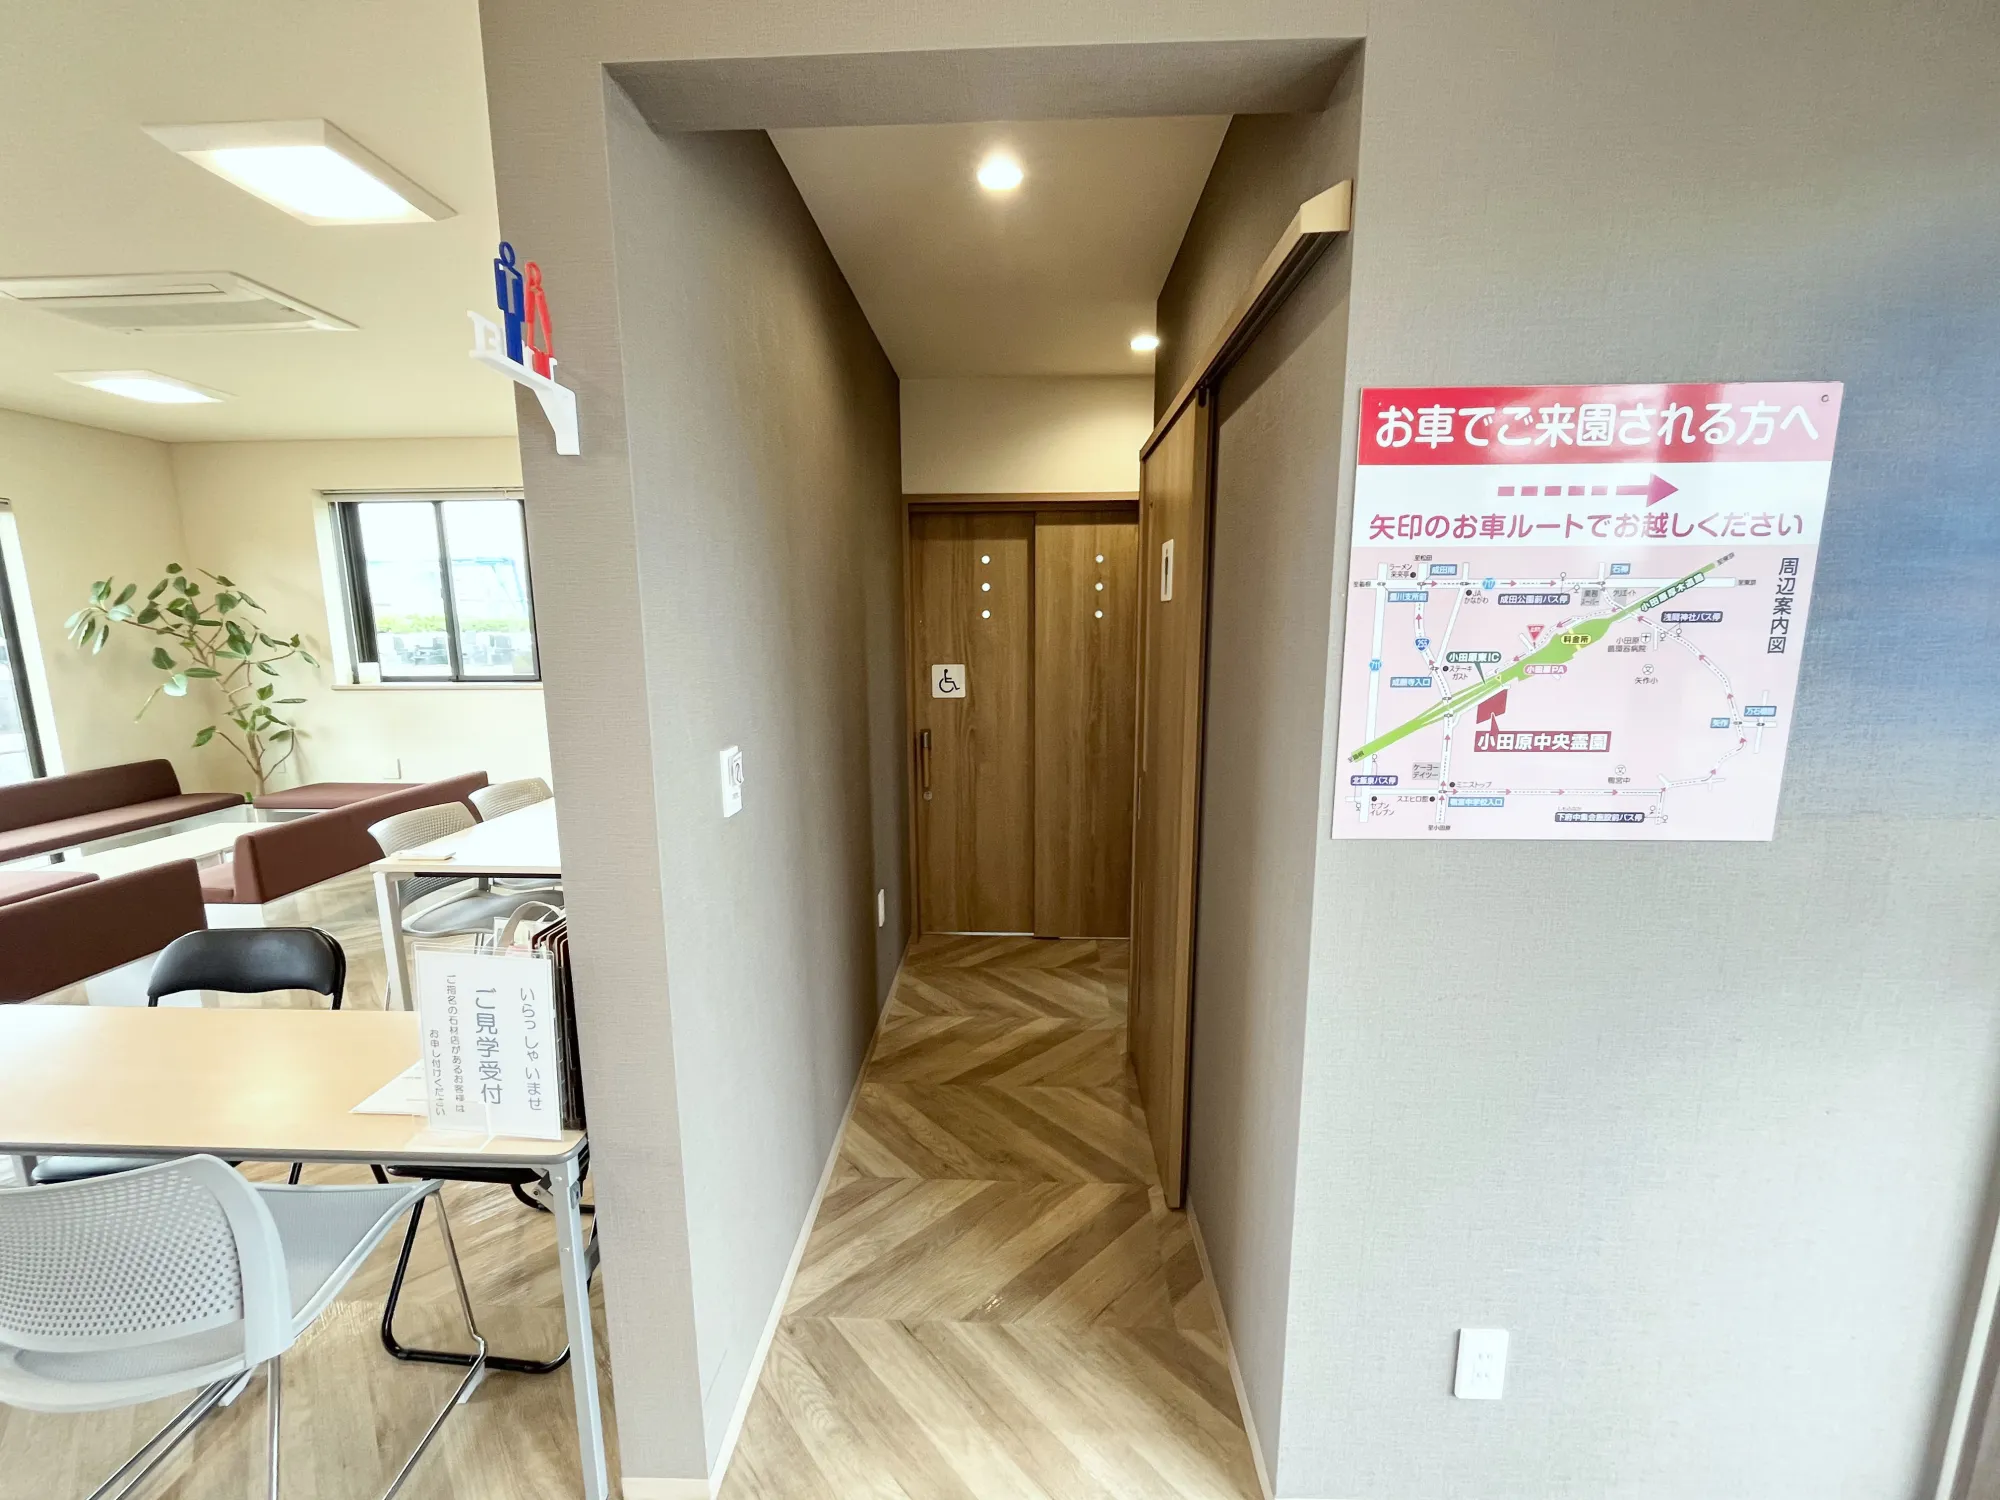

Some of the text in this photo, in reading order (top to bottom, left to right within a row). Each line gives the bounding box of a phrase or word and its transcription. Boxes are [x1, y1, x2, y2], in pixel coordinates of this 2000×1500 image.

[1376, 402, 1819, 448] お車でご来園される方へ
[1368, 512, 1803, 541] 矢印のお車ルートでお越しください
[1499, 594, 1568, 604] 成田公園前バス停
[1767, 557, 1799, 654] 周辺案内図
[1563, 635, 1589, 644] 料金所
[1616, 636, 1639, 644] 小田原
[1448, 653, 1500, 663] 小田原東IC
[1449, 665, 1472, 673] ステーキ
[1526, 665, 1565, 674] 小田原PA
[1452, 673, 1469, 681] ガスト
[1477, 732, 1608, 751] 小田原中央霊園
[1413, 763, 1440, 771] ケーヨー
[1413, 771, 1439, 779] デイツー
[475, 987, 503, 1105] ご見学受付
[520, 987, 542, 1111] いらっしゃいませ
[429, 1029, 446, 1116] お申し付けください
